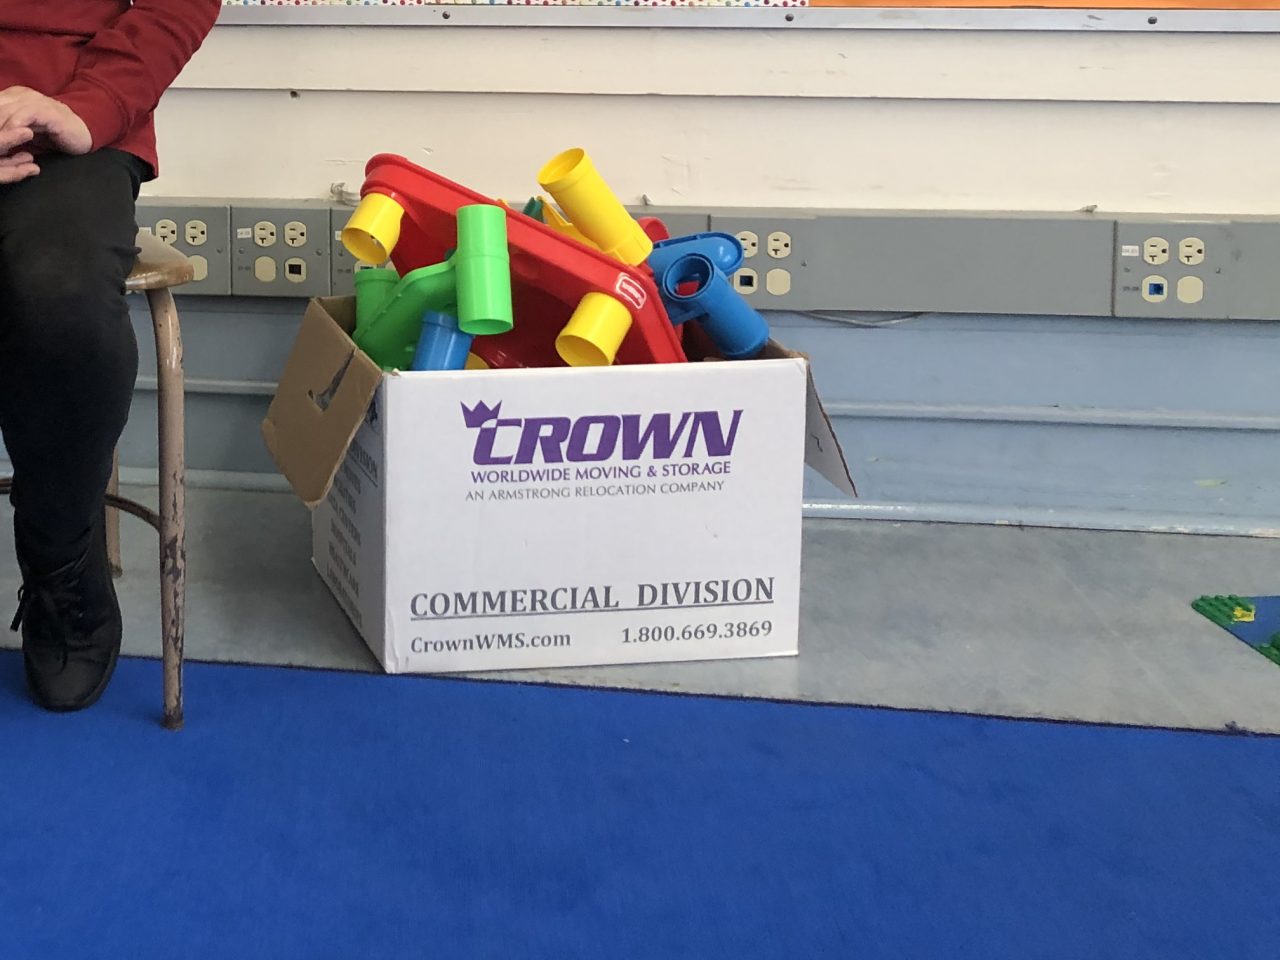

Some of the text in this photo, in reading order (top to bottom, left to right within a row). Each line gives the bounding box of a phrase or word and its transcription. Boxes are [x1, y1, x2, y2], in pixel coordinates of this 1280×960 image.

[469, 408, 744, 466] CROWN
[471, 461, 731, 484] WORLDWIDE MOVING & STORAGE
[465, 480, 724, 501] AN ARMSTRONG RELOCATION COMPANY
[410, 577, 775, 617] COMMERCIAL DIVISION
[410, 620, 773, 654] CrownWMS.com 1.800.669.3869
